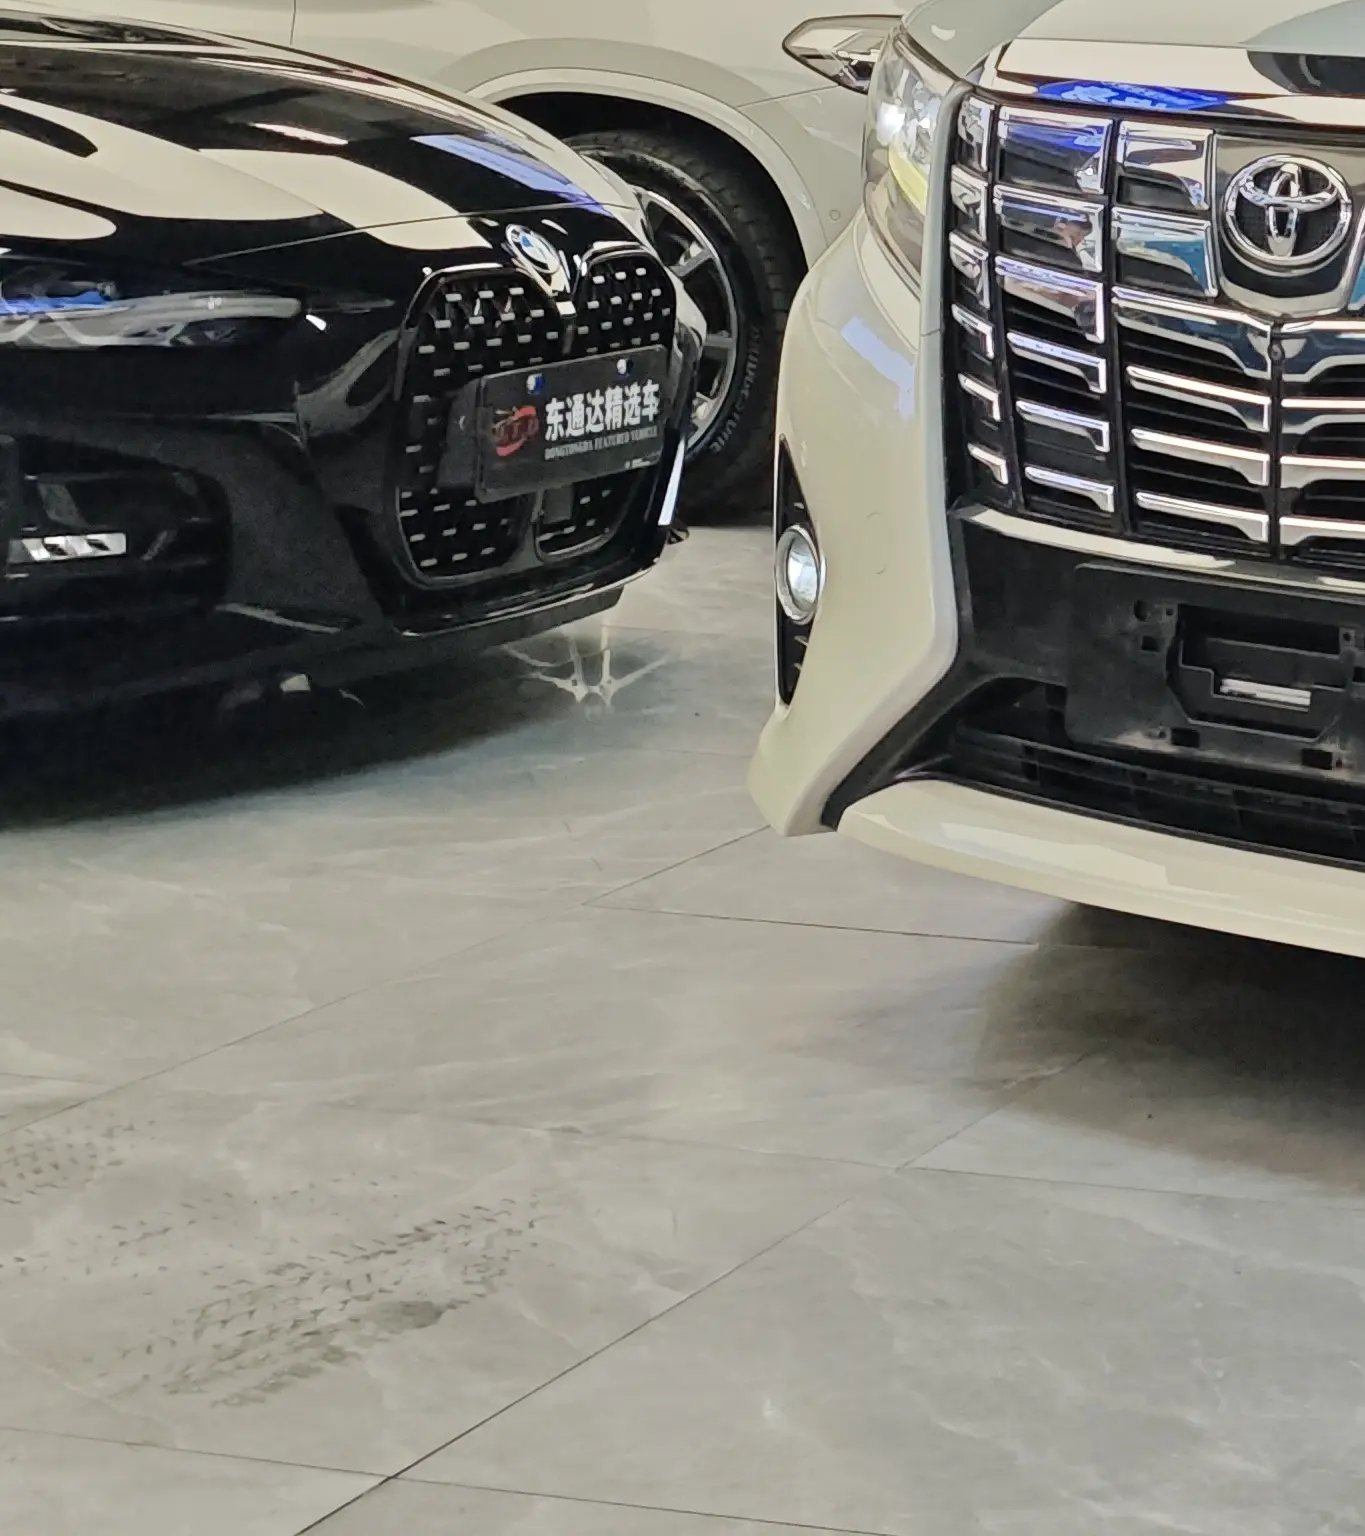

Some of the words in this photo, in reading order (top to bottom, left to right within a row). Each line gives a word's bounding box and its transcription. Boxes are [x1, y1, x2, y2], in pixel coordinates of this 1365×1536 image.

[545, 379, 660, 441] 东通达精选车
